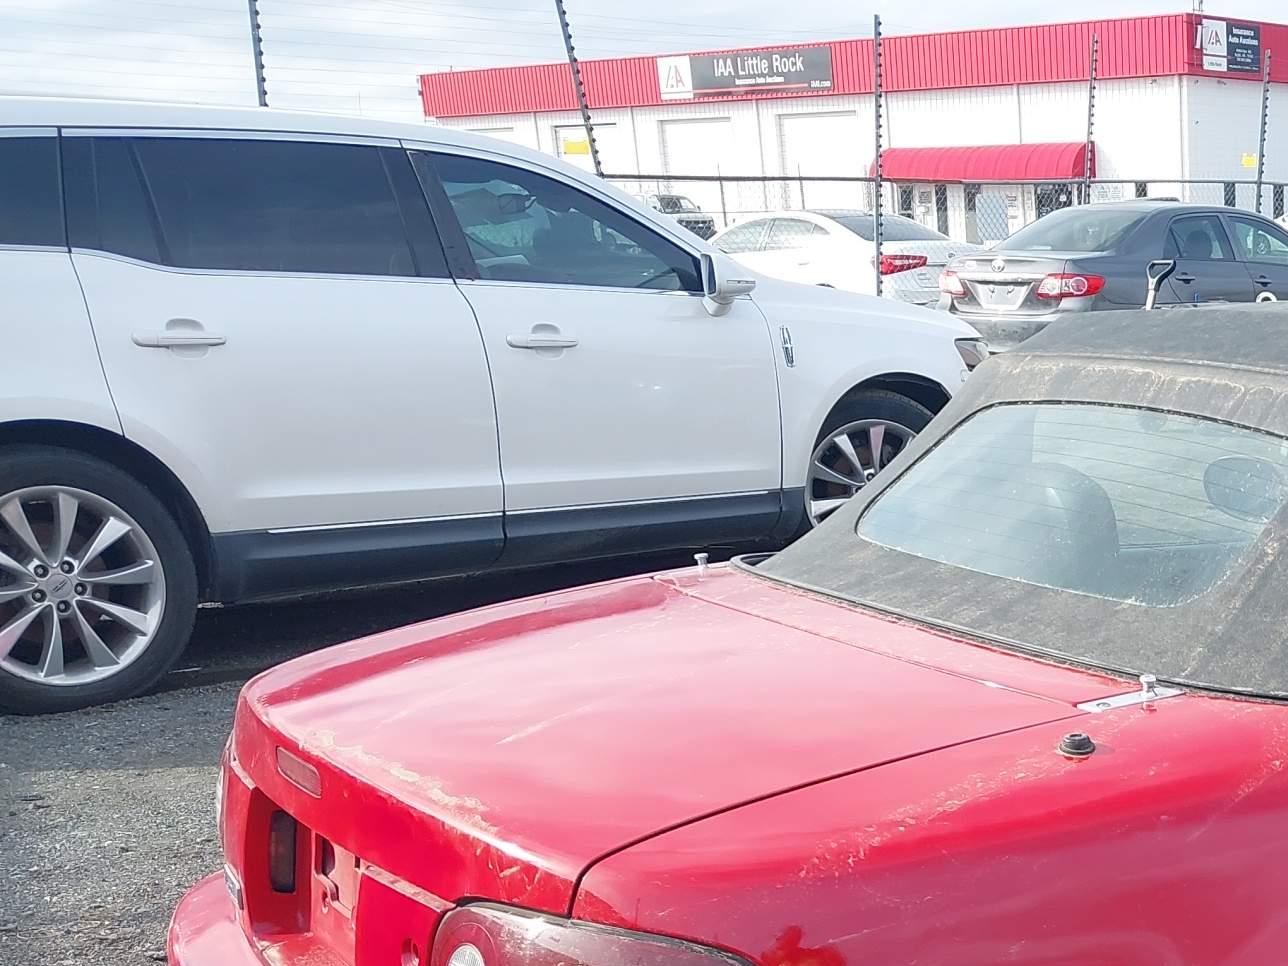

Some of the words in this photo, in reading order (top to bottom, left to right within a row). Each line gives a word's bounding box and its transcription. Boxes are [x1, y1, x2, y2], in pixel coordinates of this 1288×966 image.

[713, 58, 734, 77] IAA
[737, 54, 769, 76] Little
[772, 52, 804, 73] Rock
